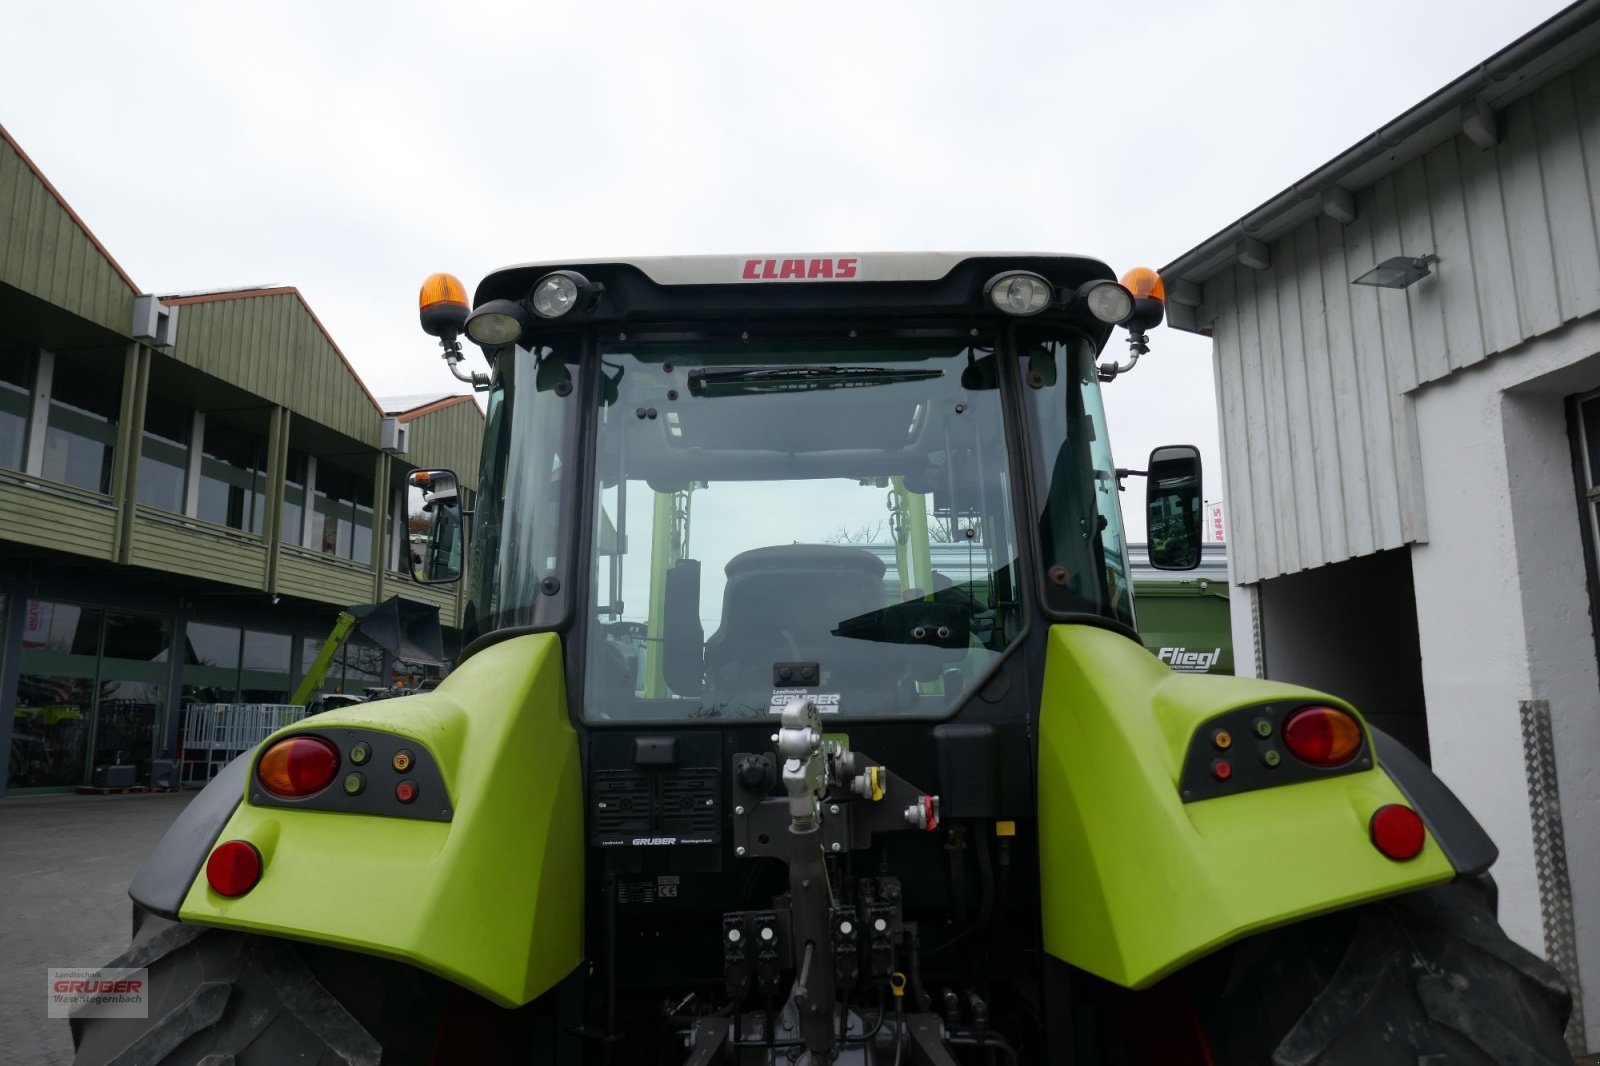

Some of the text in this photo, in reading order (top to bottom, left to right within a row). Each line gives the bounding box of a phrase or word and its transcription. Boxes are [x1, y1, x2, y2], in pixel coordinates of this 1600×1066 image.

[742, 258, 858, 279] CLAAS
[1213, 508, 1224, 543] AAS
[1157, 647, 1221, 670] Fliegl
[632, 837, 677, 846] GRUBER
